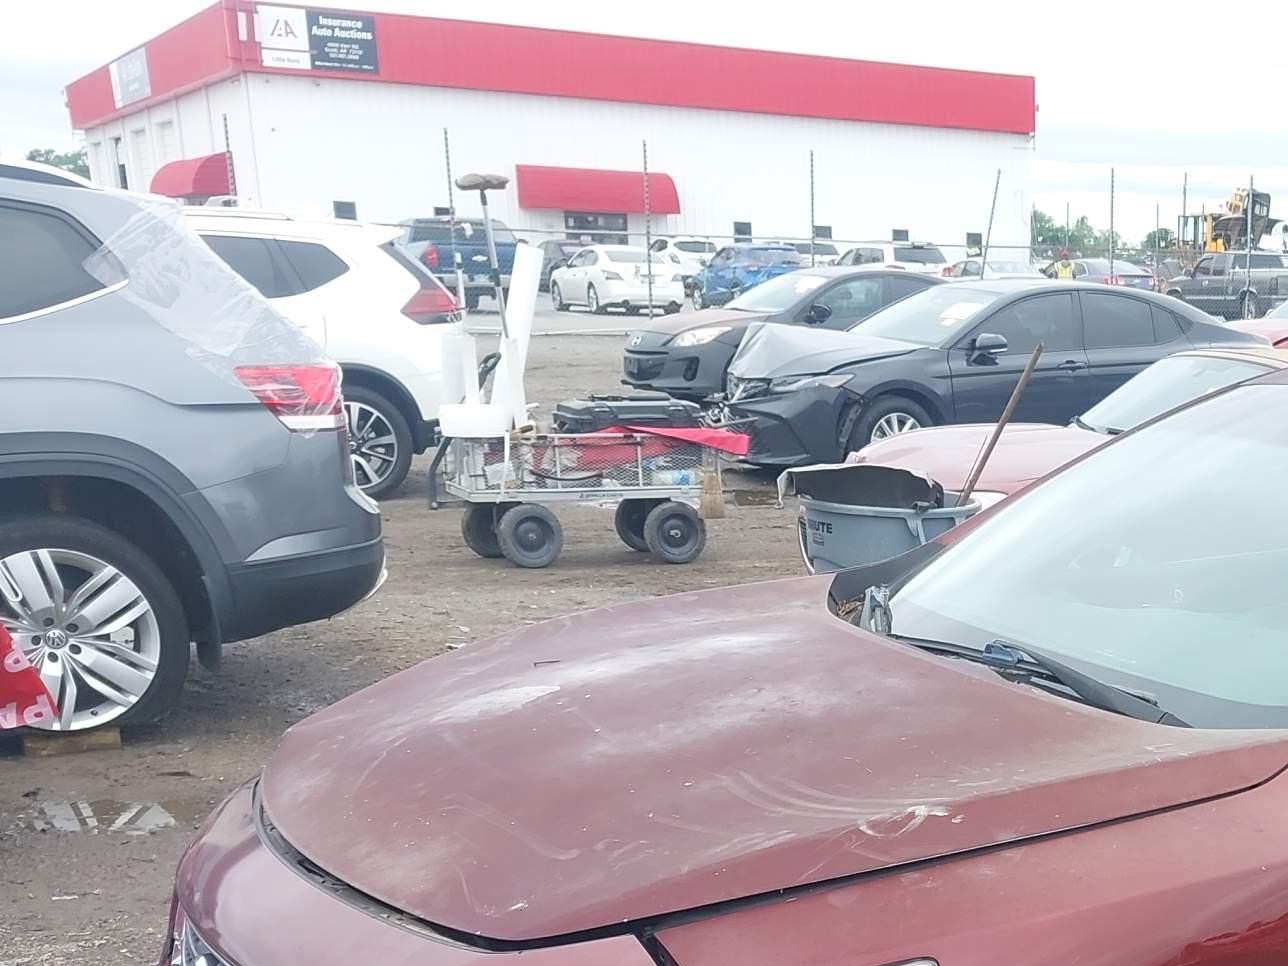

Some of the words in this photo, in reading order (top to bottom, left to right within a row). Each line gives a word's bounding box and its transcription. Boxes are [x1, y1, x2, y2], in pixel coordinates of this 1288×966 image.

[319, 16, 363, 29] Insurance
[311, 26, 332, 37] Auto
[333, 28, 373, 40] Auctions
